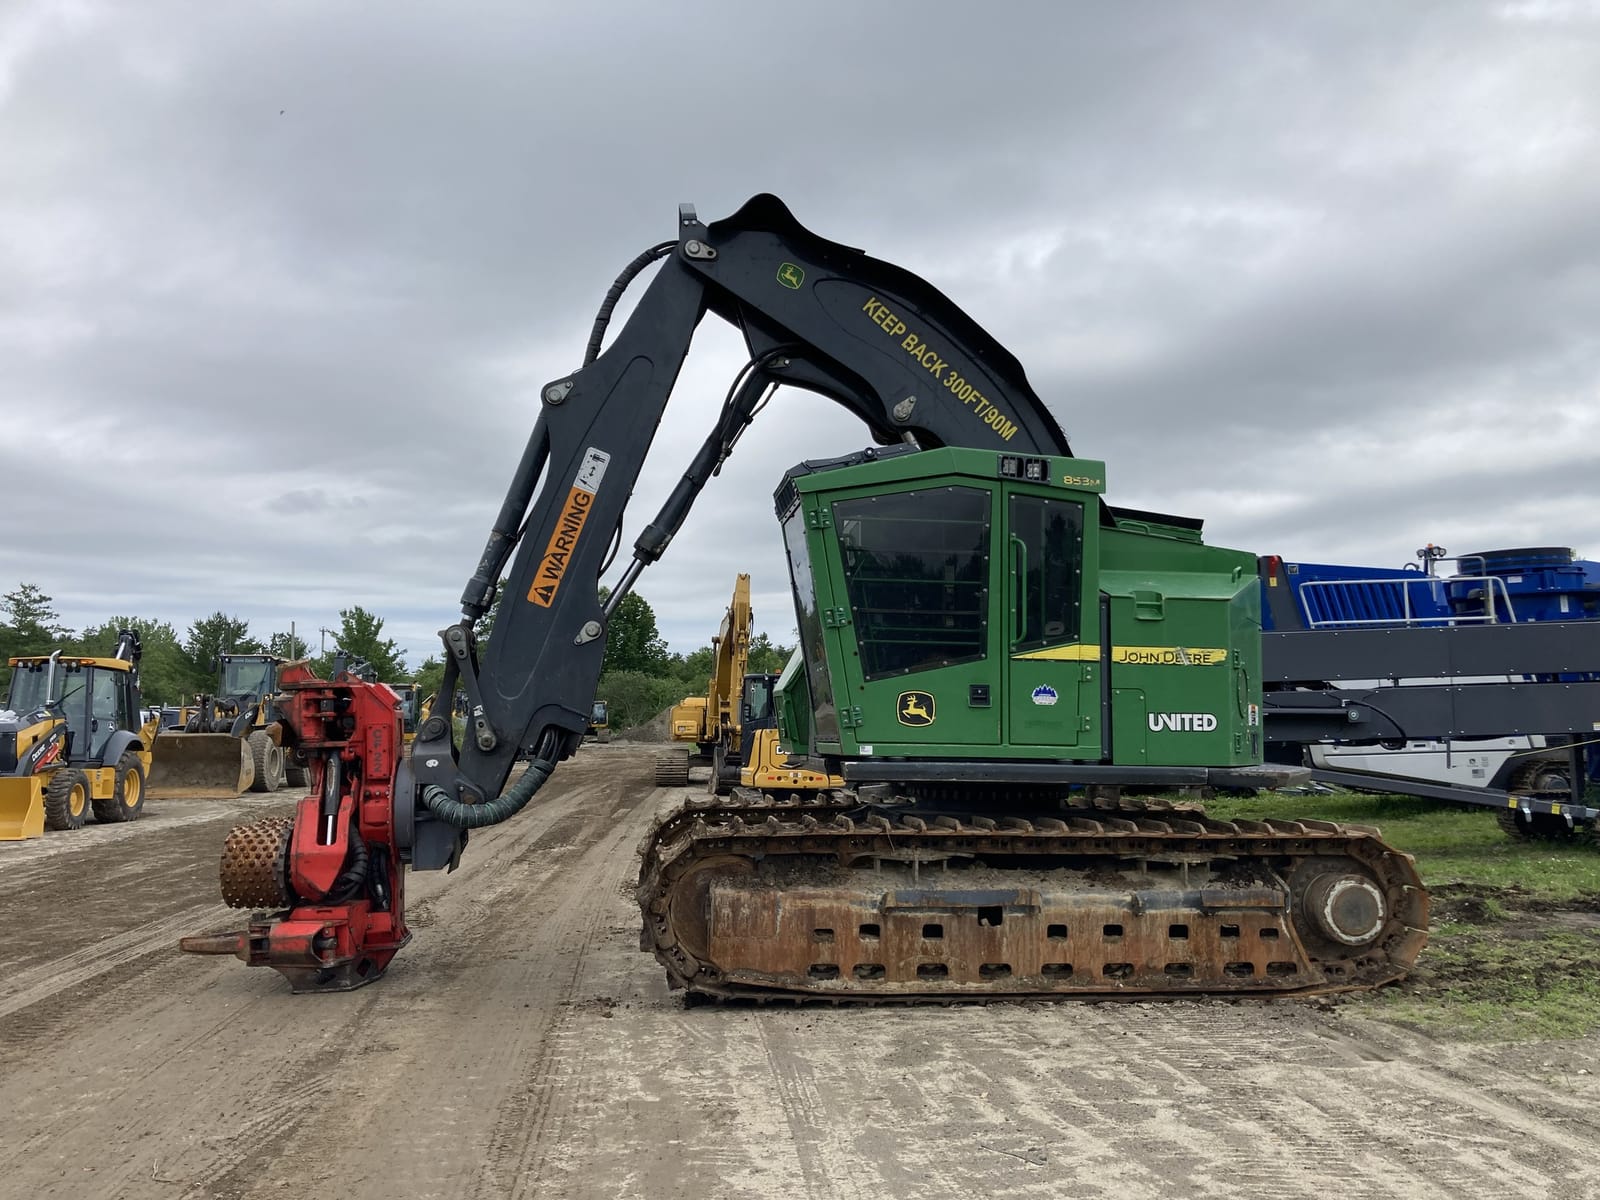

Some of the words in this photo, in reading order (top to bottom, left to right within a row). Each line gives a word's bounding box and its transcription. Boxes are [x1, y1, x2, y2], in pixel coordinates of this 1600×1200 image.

[862, 297, 906, 337] KEEP
[901, 333, 949, 379] BACK
[943, 371, 1018, 441] 300FT/90M
[542, 492, 591, 580] WARNING
[1120, 650, 1160, 663] JOHN
[1148, 712, 1217, 732] UNITED
